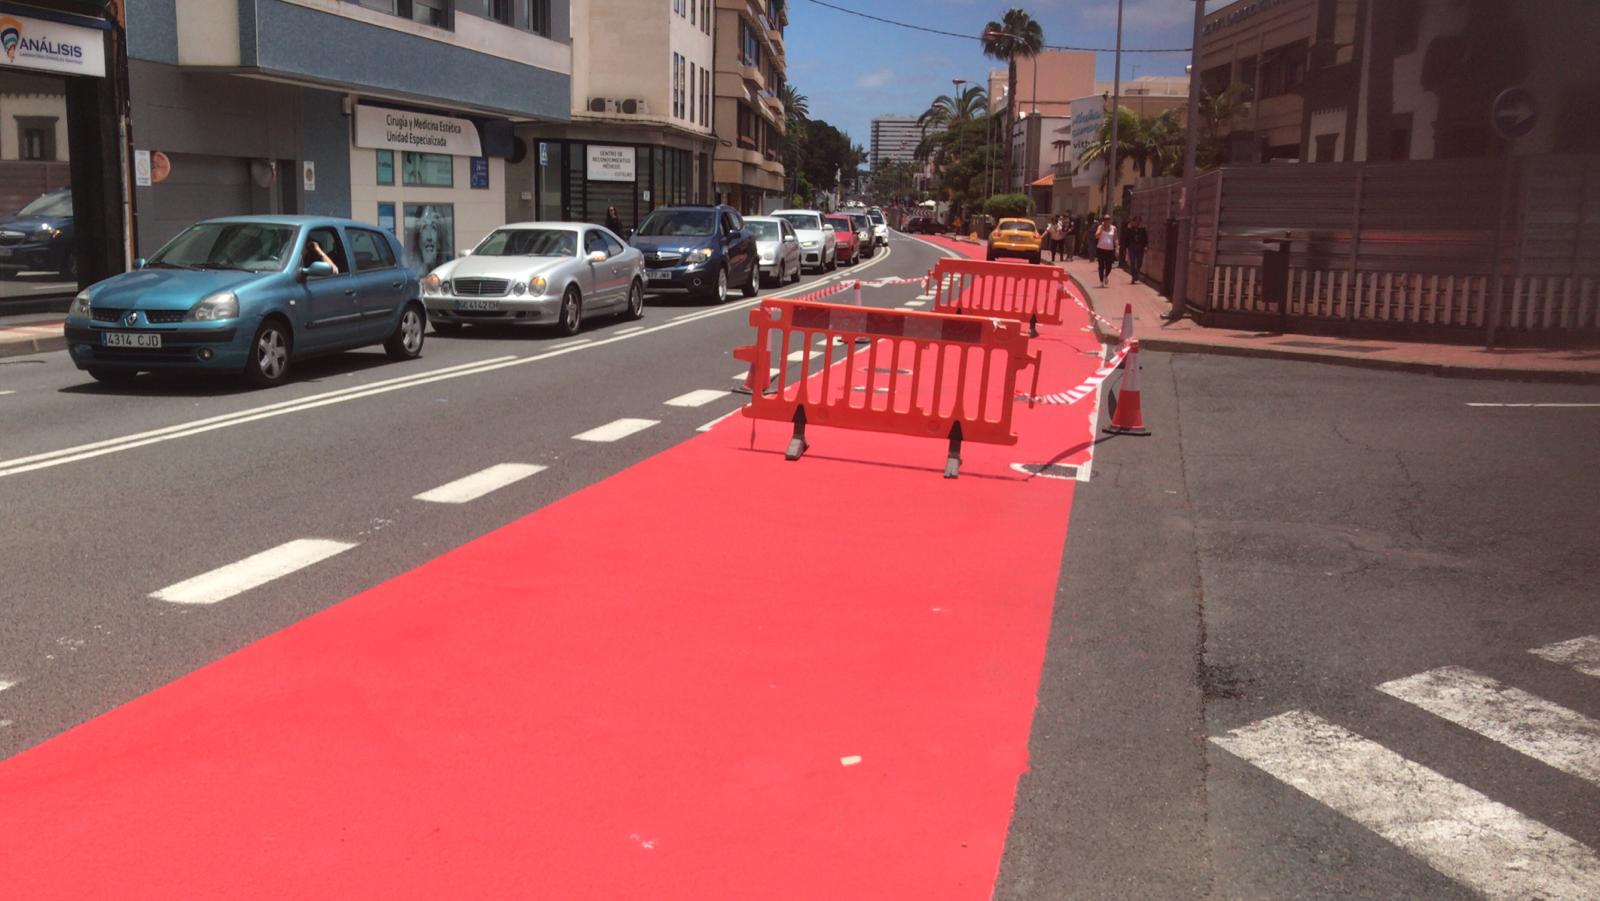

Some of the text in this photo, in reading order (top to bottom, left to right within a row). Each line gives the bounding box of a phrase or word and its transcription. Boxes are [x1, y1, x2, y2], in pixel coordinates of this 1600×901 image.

[20, 36, 82, 58] ANÁLISIS
[386, 114, 462, 134] Cirugía y Medicina Estética
[386, 130, 447, 147] Unidad Especializada
[108, 334, 158, 347] 4314 CJD
